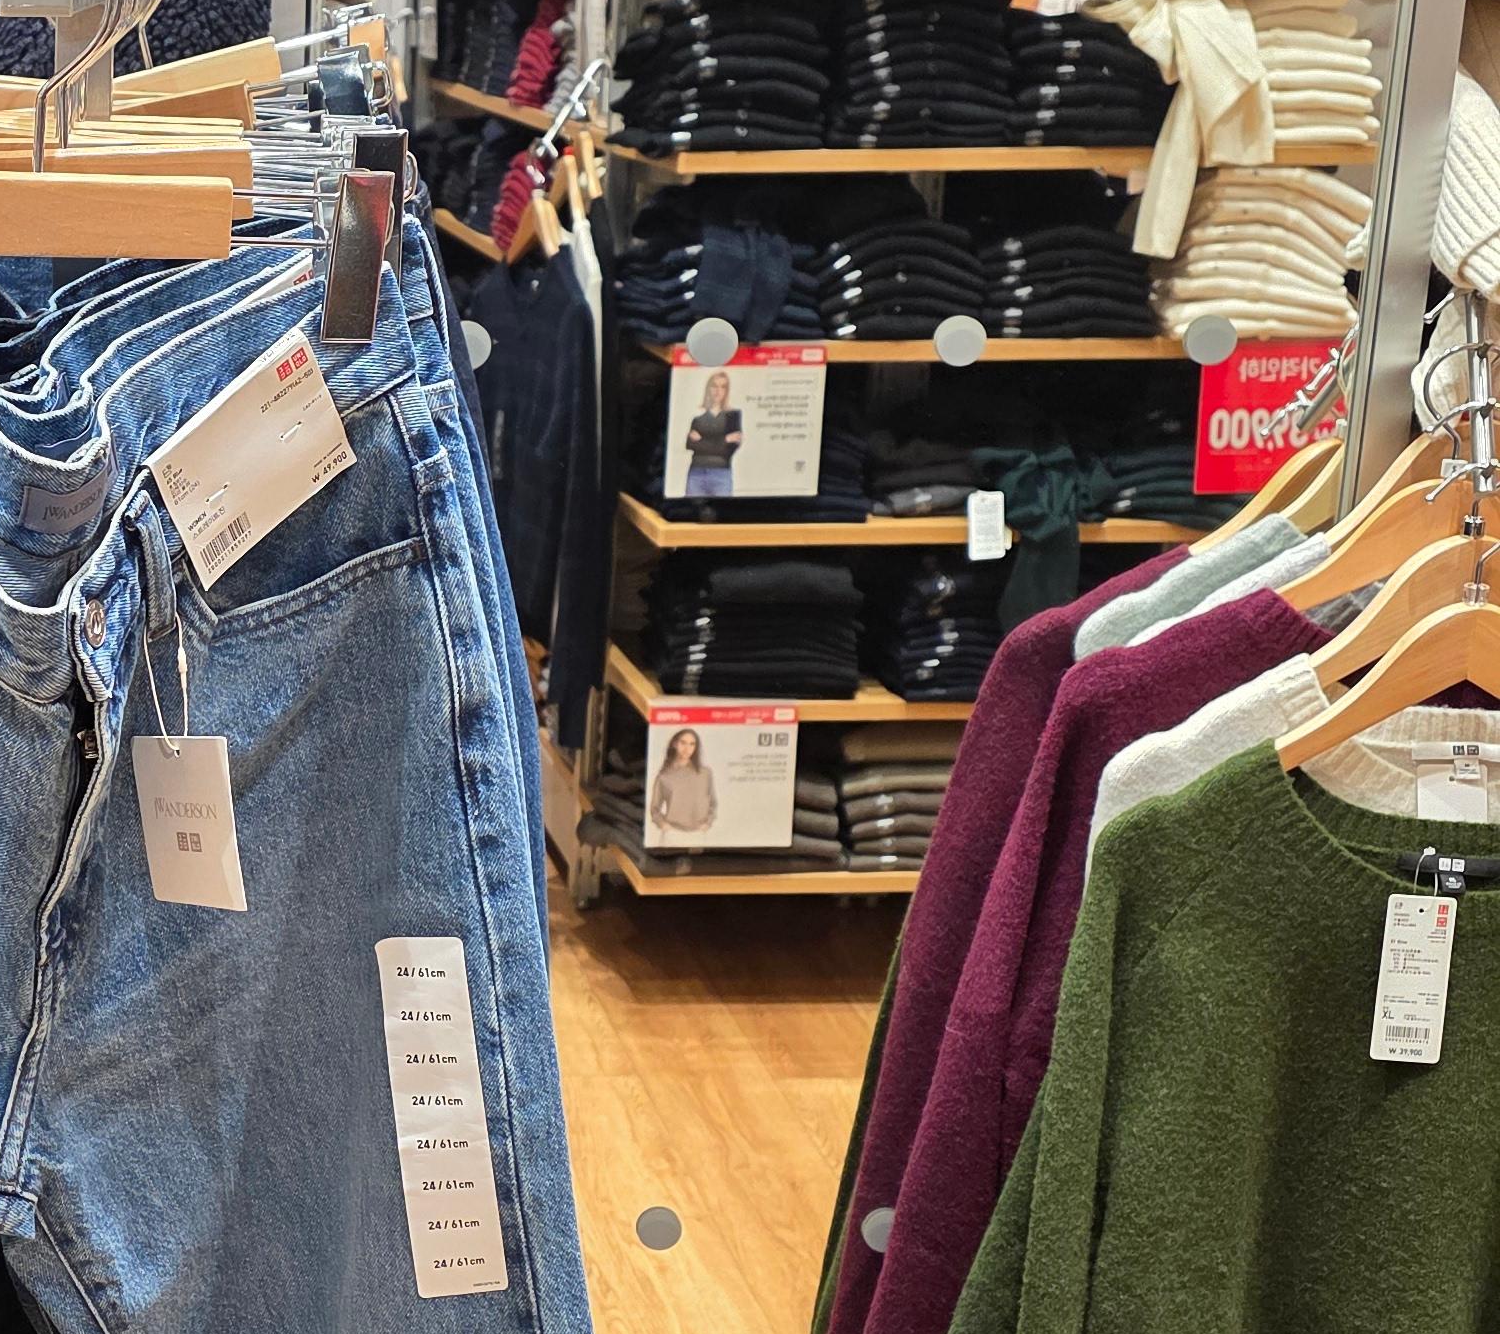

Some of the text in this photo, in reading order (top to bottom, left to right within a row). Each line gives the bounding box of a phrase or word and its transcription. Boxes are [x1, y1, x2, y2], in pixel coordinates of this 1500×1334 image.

[322, 450, 348, 475] 49,900
[188, 511, 207, 532] WOMEN
[397, 967, 409, 977] 24
[418, 968, 446, 978] 61cm
[400, 1011, 413, 1021] 24
[423, 1011, 451, 1021] 61cm
[1382, 1010, 1395, 1020] XL
[406, 1054, 419, 1064] 24
[429, 1054, 458, 1064] 61cm
[411, 1096, 425, 1106] 24
[435, 1096, 463, 1106] 61cm
[416, 1139, 429, 1150] 24
[439, 1139, 469, 1149] 61cm
[422, 1181, 436, 1191] 24
[445, 1180, 475, 1190] 61cm
[428, 1221, 442, 1230] 24
[451, 1219, 480, 1229] 61cm
[433, 1259, 447, 1269] 24
[456, 1257, 486, 1267] 61cm
